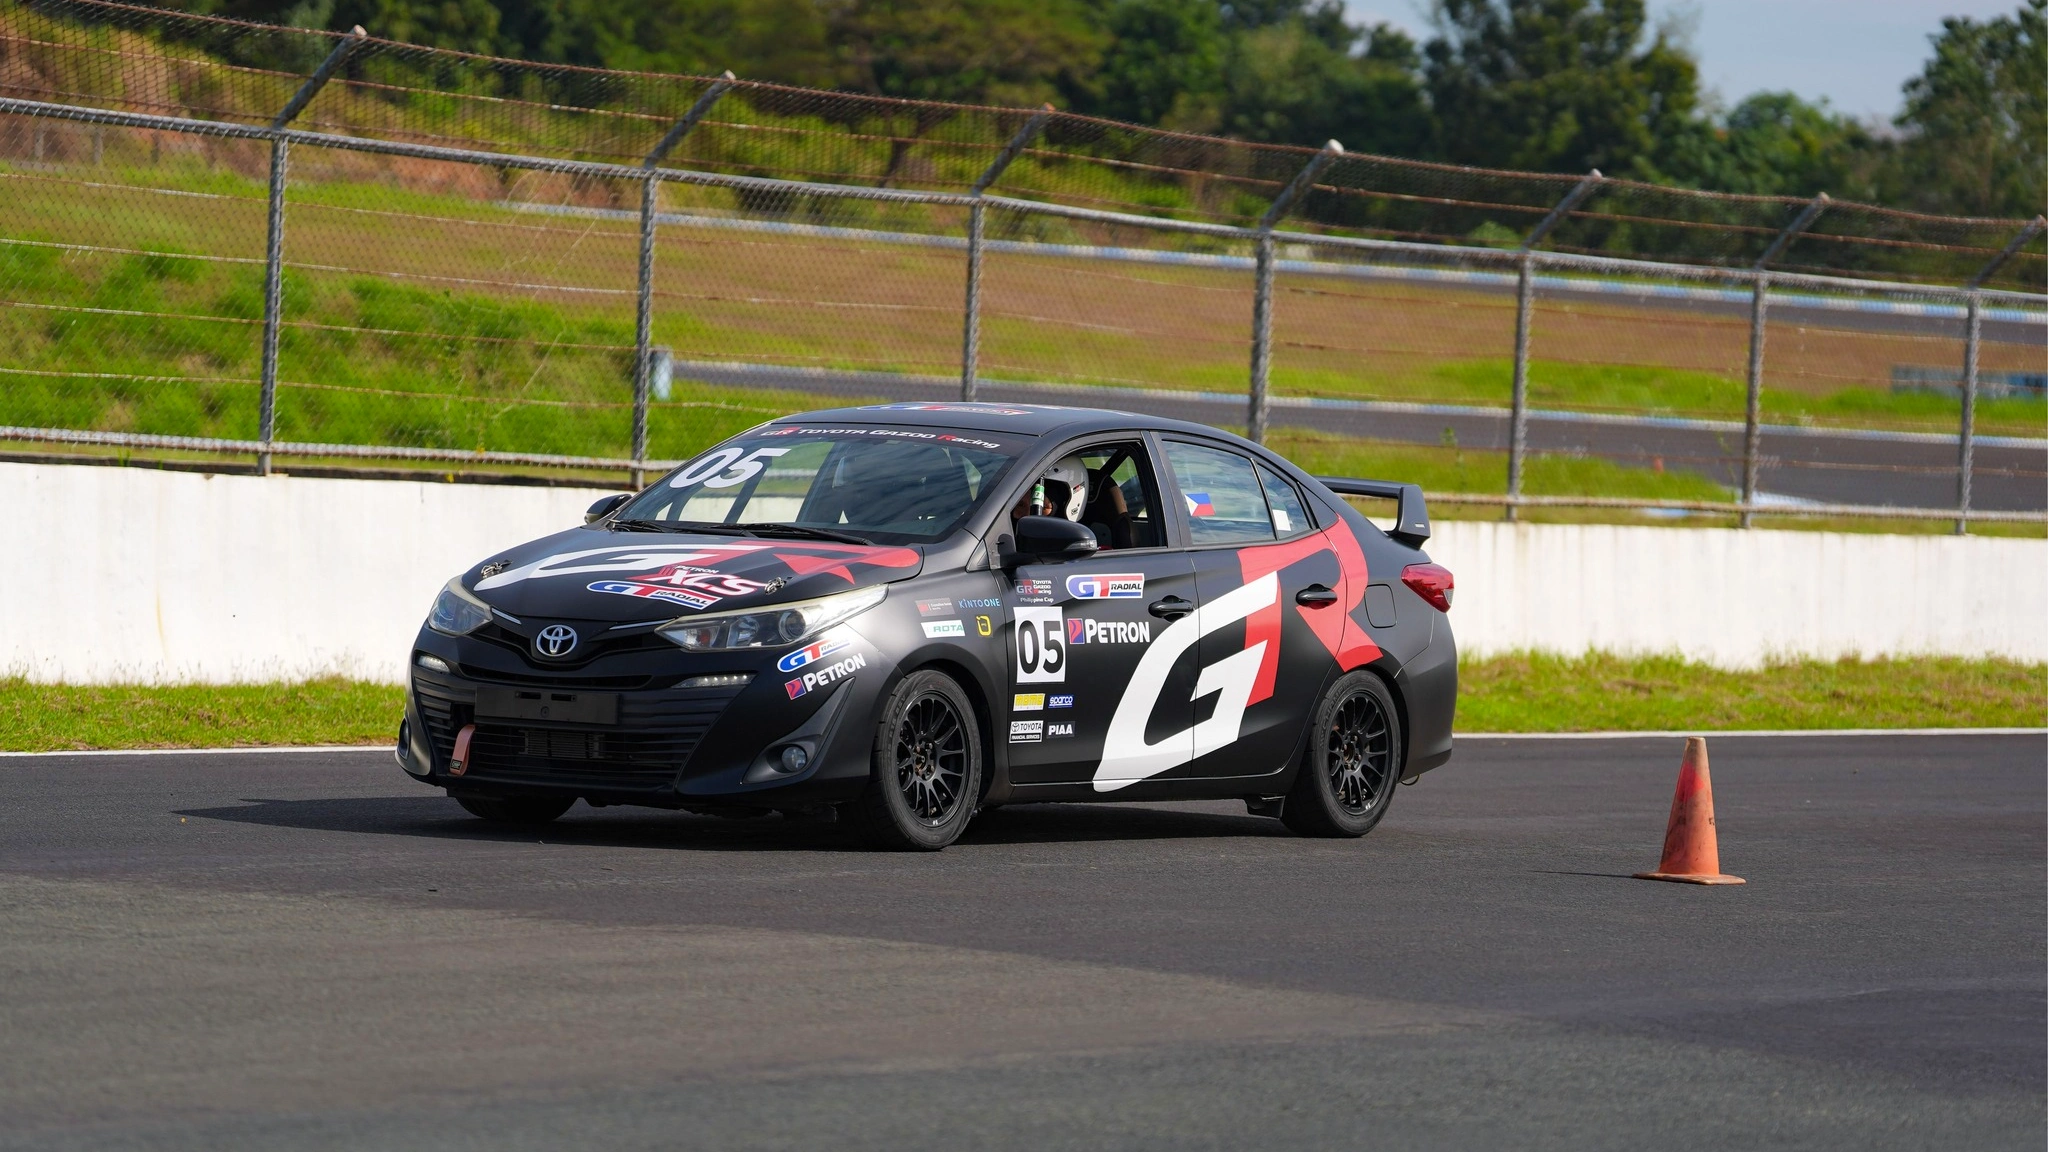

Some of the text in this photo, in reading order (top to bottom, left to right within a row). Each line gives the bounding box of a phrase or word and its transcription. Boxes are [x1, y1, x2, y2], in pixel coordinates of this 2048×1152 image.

[869, 429, 937, 439] GAZOO
[937, 434, 1001, 449] Racing
[669, 447, 791, 488] 05
[674, 565, 719, 574] PETRON
[588, 581, 709, 606] GT RADIAL
[1016, 585, 1033, 594] GR
[1068, 576, 1110, 597] GT
[1085, 618, 1150, 643] PETRON
[780, 640, 824, 671] GT
[1018, 620, 1064, 674] 05
[1092, 515, 1384, 793] GR
[803, 652, 866, 692] PETRON
[1048, 724, 1073, 736] PIAA
